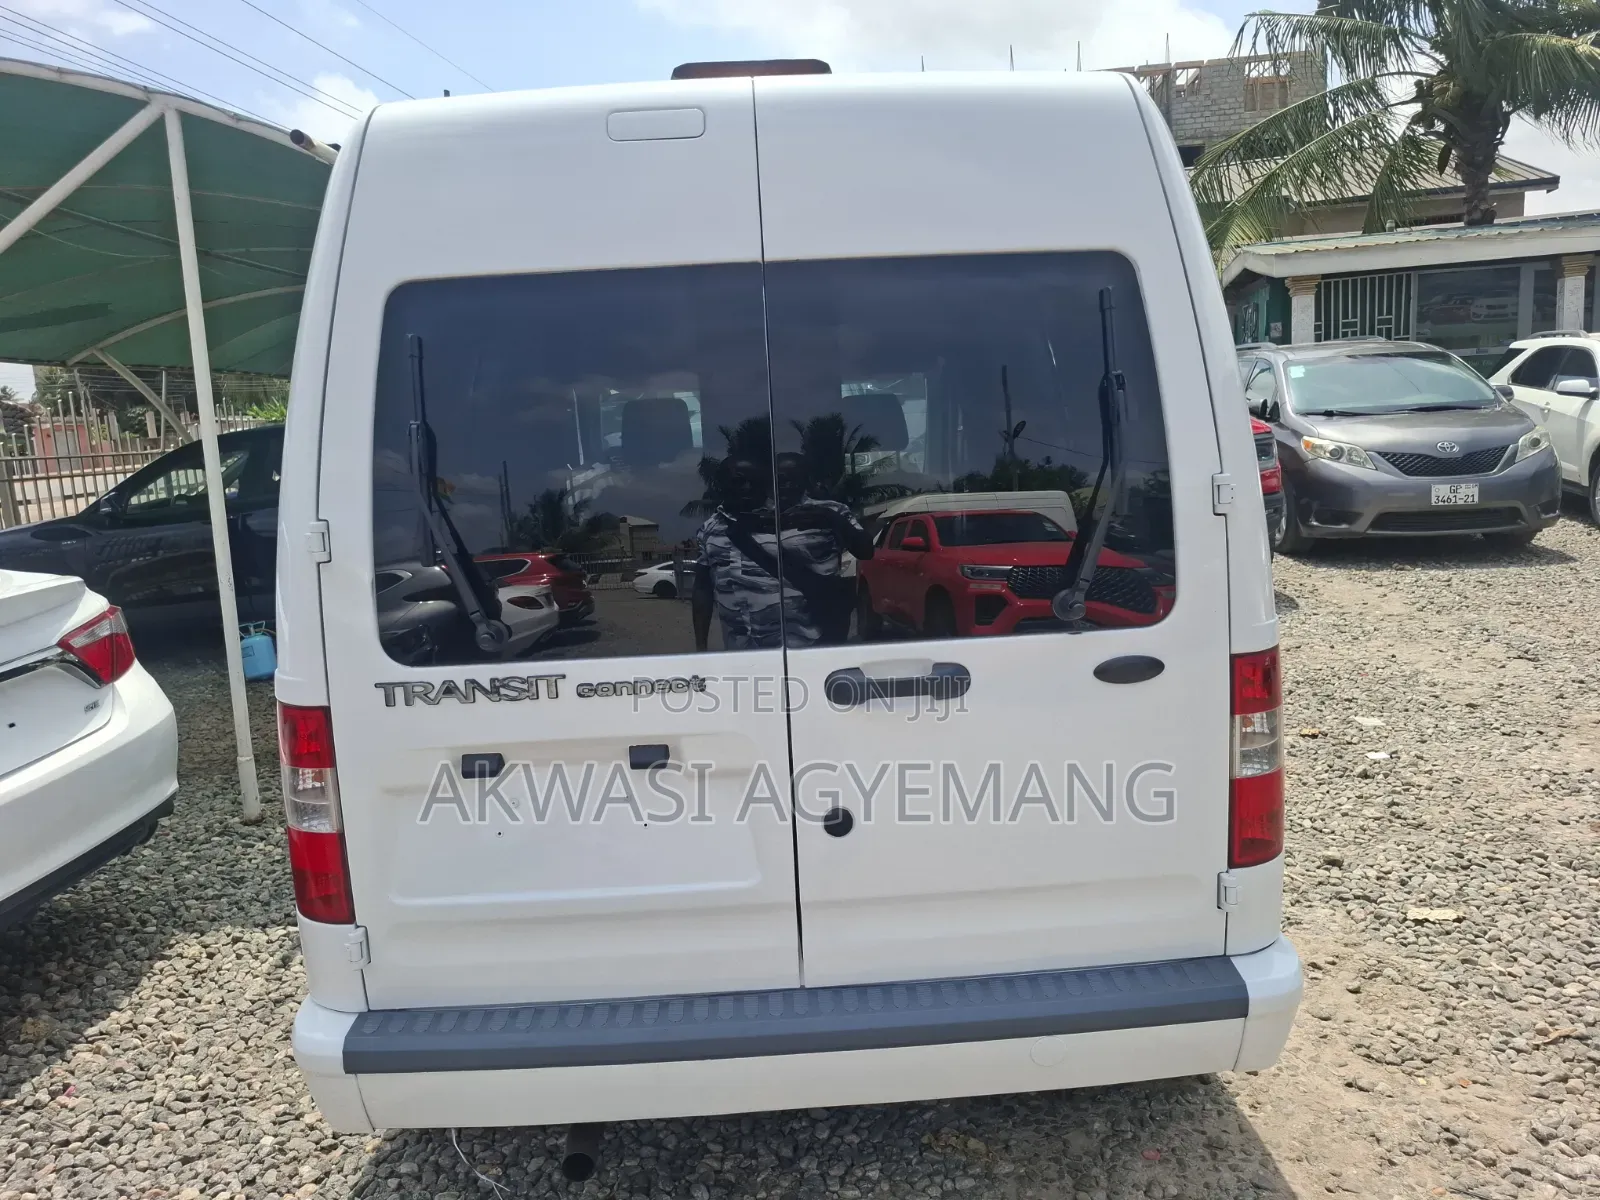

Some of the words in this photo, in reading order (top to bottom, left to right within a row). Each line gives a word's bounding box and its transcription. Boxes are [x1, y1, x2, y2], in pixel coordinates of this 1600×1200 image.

[1434, 494, 1476, 504] 3461-21
[374, 674, 567, 707] TRANSIT
[576, 675, 707, 698] connect
